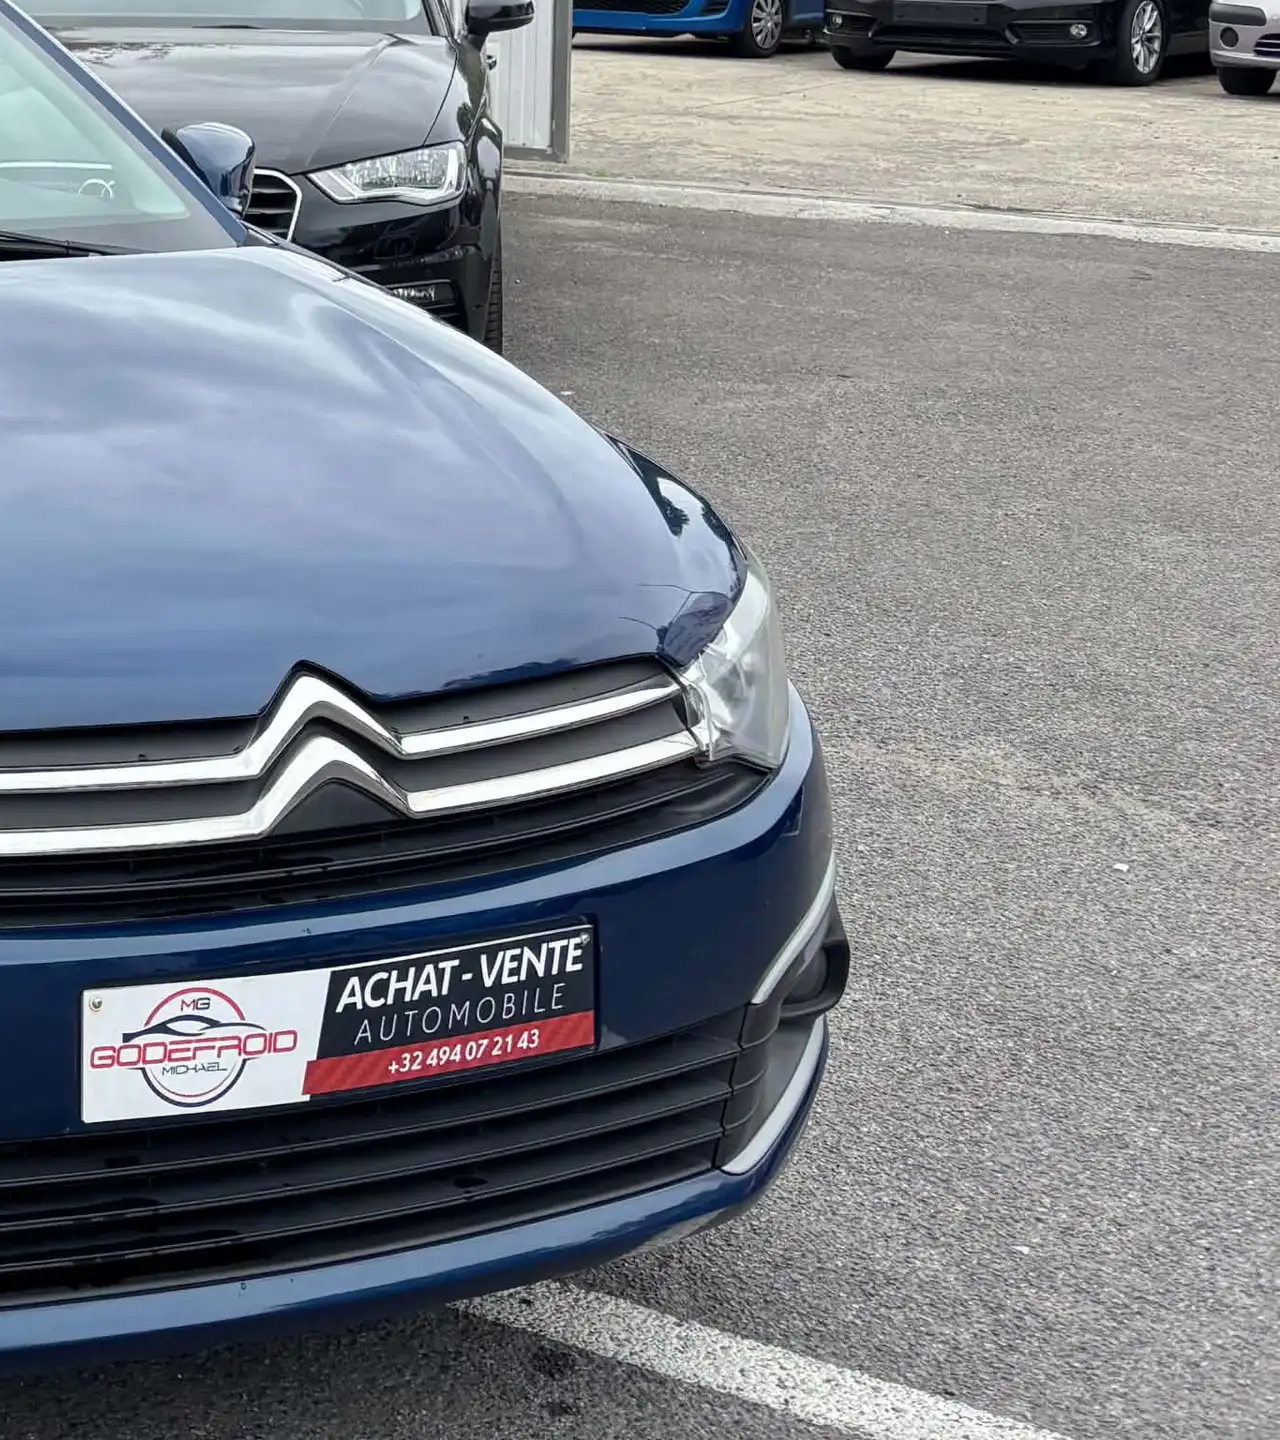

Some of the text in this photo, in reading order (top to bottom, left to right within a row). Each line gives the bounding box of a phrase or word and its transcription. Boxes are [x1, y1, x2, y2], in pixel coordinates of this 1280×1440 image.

[180, 997, 210, 1011] MG
[354, 983, 567, 1046] AUTOMOBILE
[517, 1029, 540, 1049] 43
[90, 1029, 298, 1070] GODEFROID
[161, 1061, 228, 1077] MICHAEL
